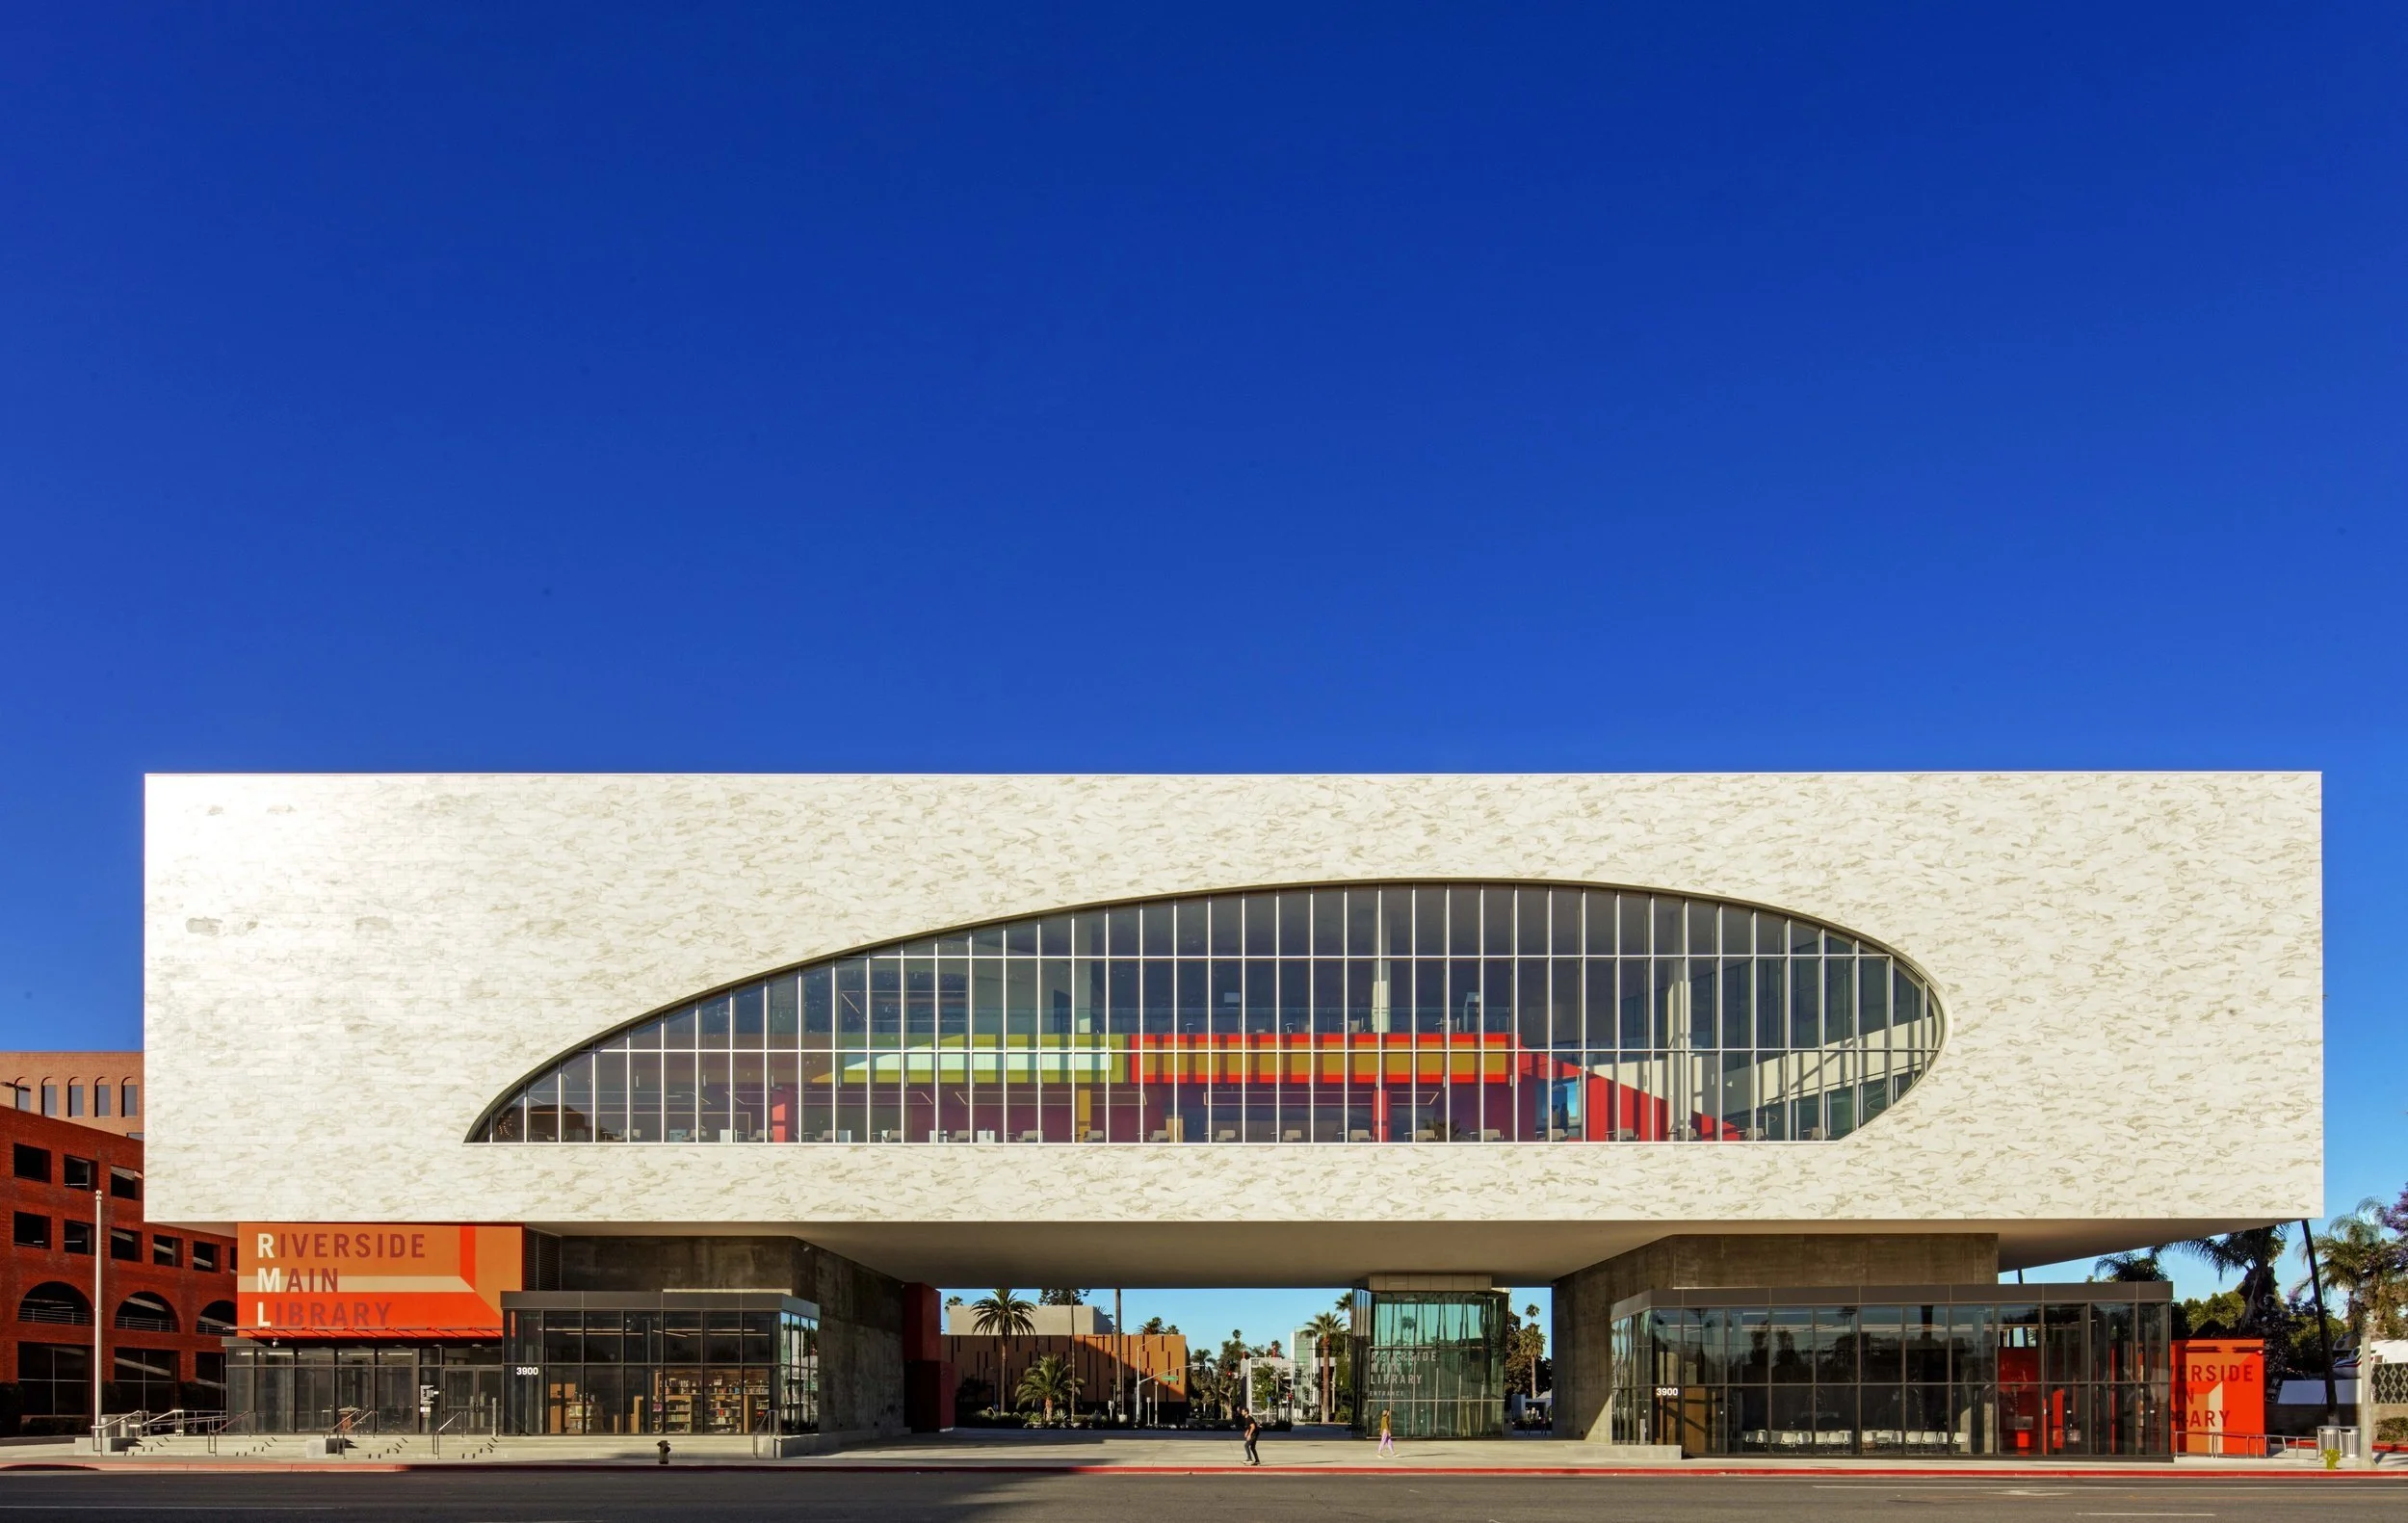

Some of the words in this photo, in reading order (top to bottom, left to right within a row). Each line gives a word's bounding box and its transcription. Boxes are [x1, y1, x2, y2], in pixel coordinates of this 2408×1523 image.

[257, 1233, 426, 1259] RIVERSIDE
[257, 1268, 339, 1293] MAIN
[257, 1301, 393, 1327] LIBRARY
[516, 1367, 539, 1376] 3900
[1370, 1374, 1423, 1384] LIBRARY
[1656, 1387, 1679, 1396] 3900
